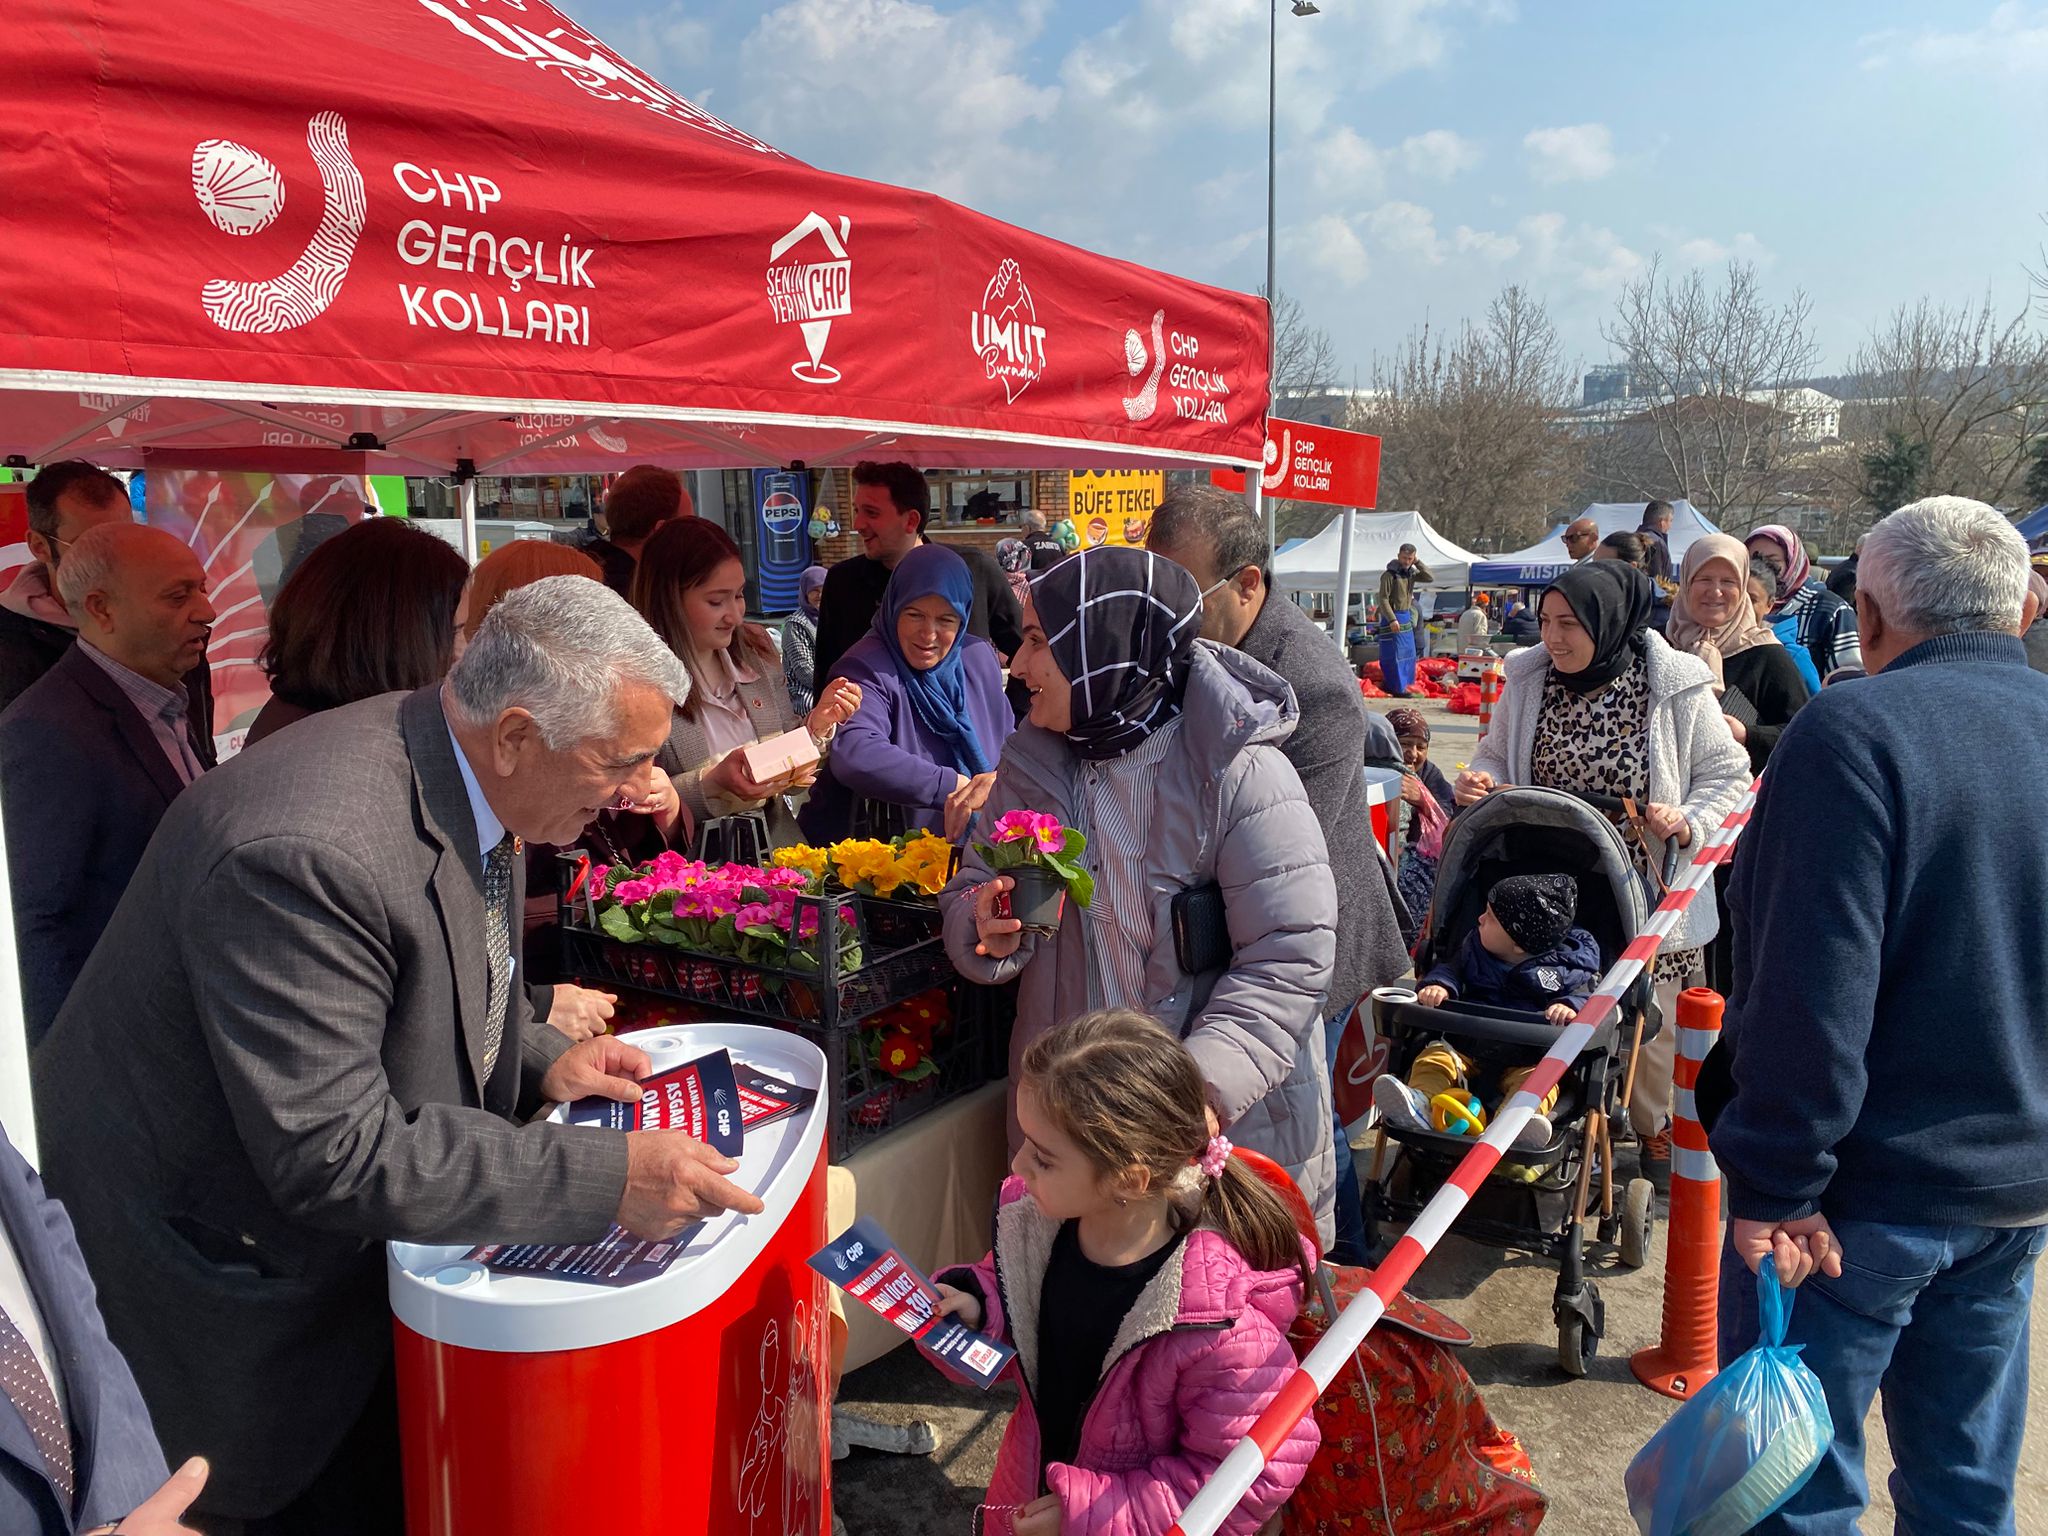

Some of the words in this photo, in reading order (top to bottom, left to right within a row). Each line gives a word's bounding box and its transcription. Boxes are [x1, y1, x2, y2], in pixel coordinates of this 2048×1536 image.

[393, 162, 501, 213] CHP
[397, 219, 596, 293] GENÇLİK
[766, 260, 806, 296] SENİN
[808, 267, 846, 312] CHP
[398, 283, 590, 346] KOLLARI
[971, 311, 1046, 367] UMUT
[1170, 331, 1199, 358] CHP
[980, 346, 1044, 383] Burada!
[1169, 363, 1230, 398] GENÇLİK
[1173, 397, 1228, 423] KOLLARI
[1295, 440, 1315, 454] CHP
[1294, 457, 1333, 476] GENÇLİK
[1293, 474, 1330, 491] KOLLARI
[765, 508, 800, 518] PEPSI
[1074, 485, 1113, 515] BÜFE
[1117, 488, 1158, 512] TEKEL
[686, 1074, 699, 1107] YALANA
[763, 1084, 788, 1094] CHP
[665, 1082, 687, 1128] ASGARİ
[692, 1106, 702, 1136] DOLANA
[717, 1109, 730, 1137] CHP
[846, 1242, 864, 1262] CHP
[878, 1256, 899, 1276] TOKUZ!
[884, 1271, 916, 1301] ÜCRET
